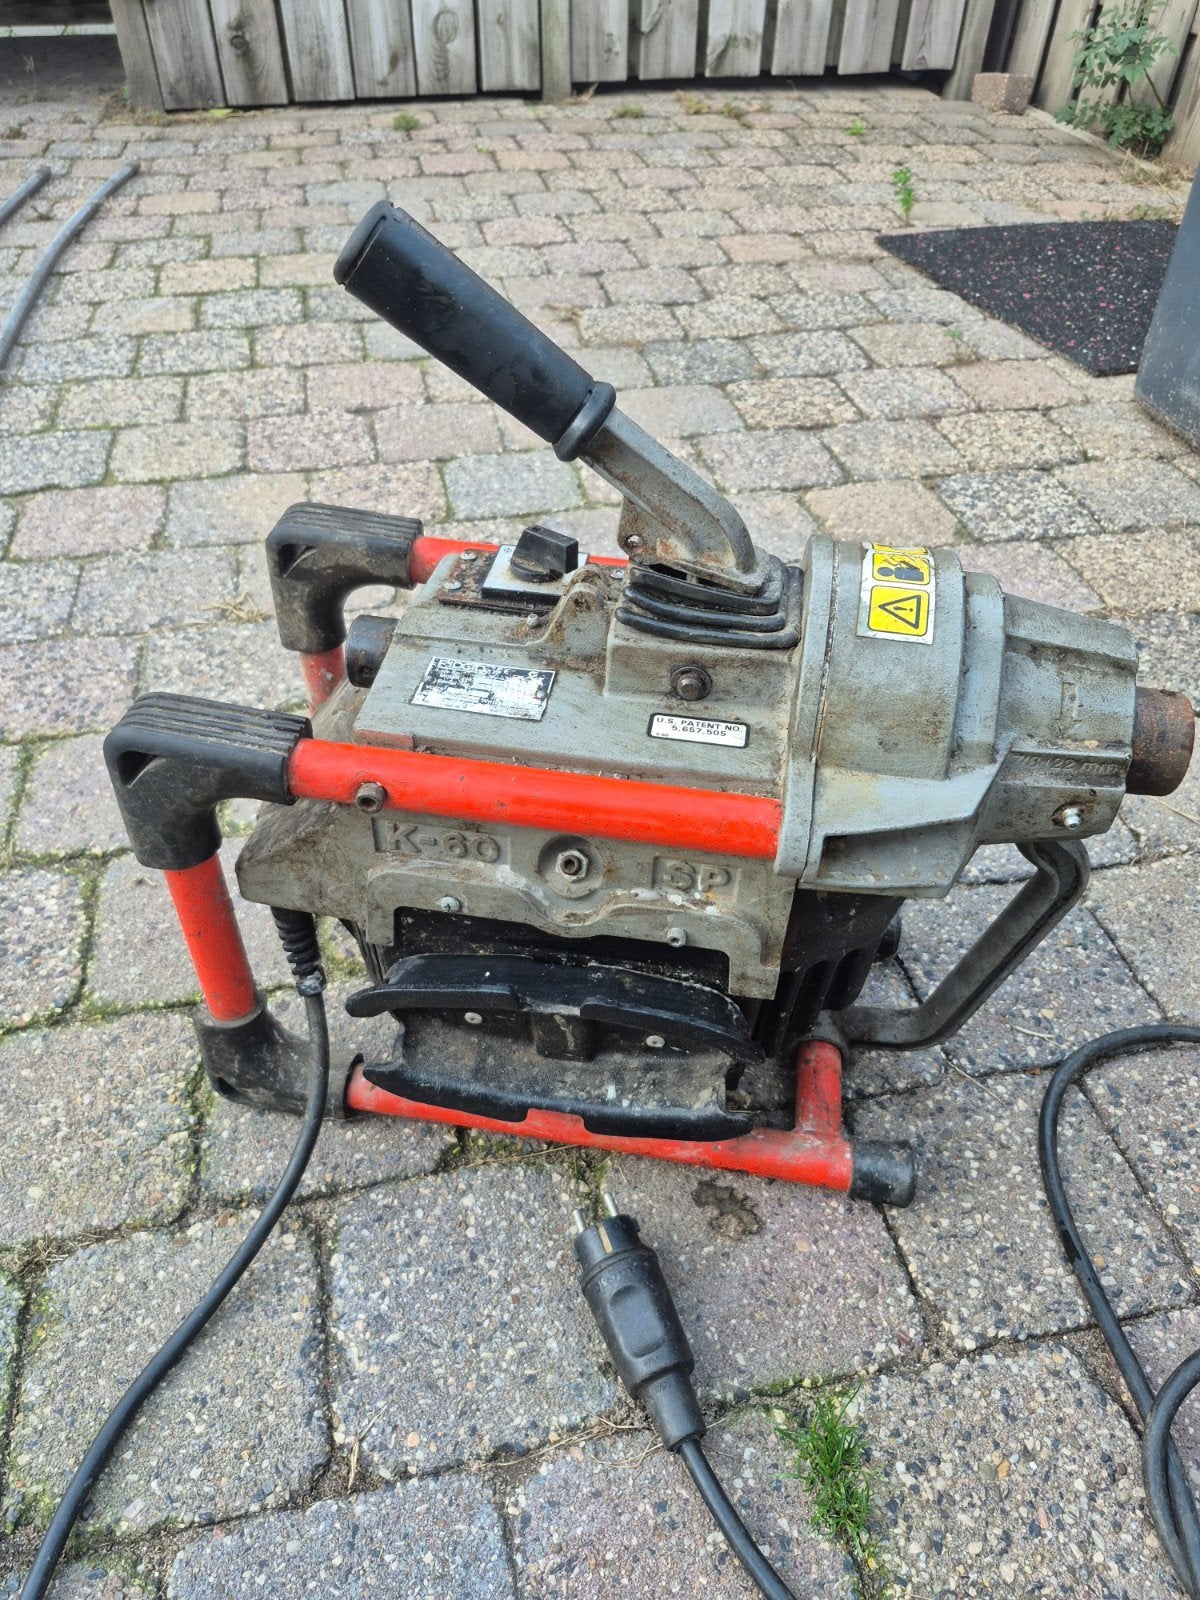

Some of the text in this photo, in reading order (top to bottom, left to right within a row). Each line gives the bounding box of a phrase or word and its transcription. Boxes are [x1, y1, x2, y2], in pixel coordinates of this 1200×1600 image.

[657, 717, 743, 733] U.S. PATENT NO.
[387, 822, 500, 864] K-60
[663, 861, 732, 892] SP
